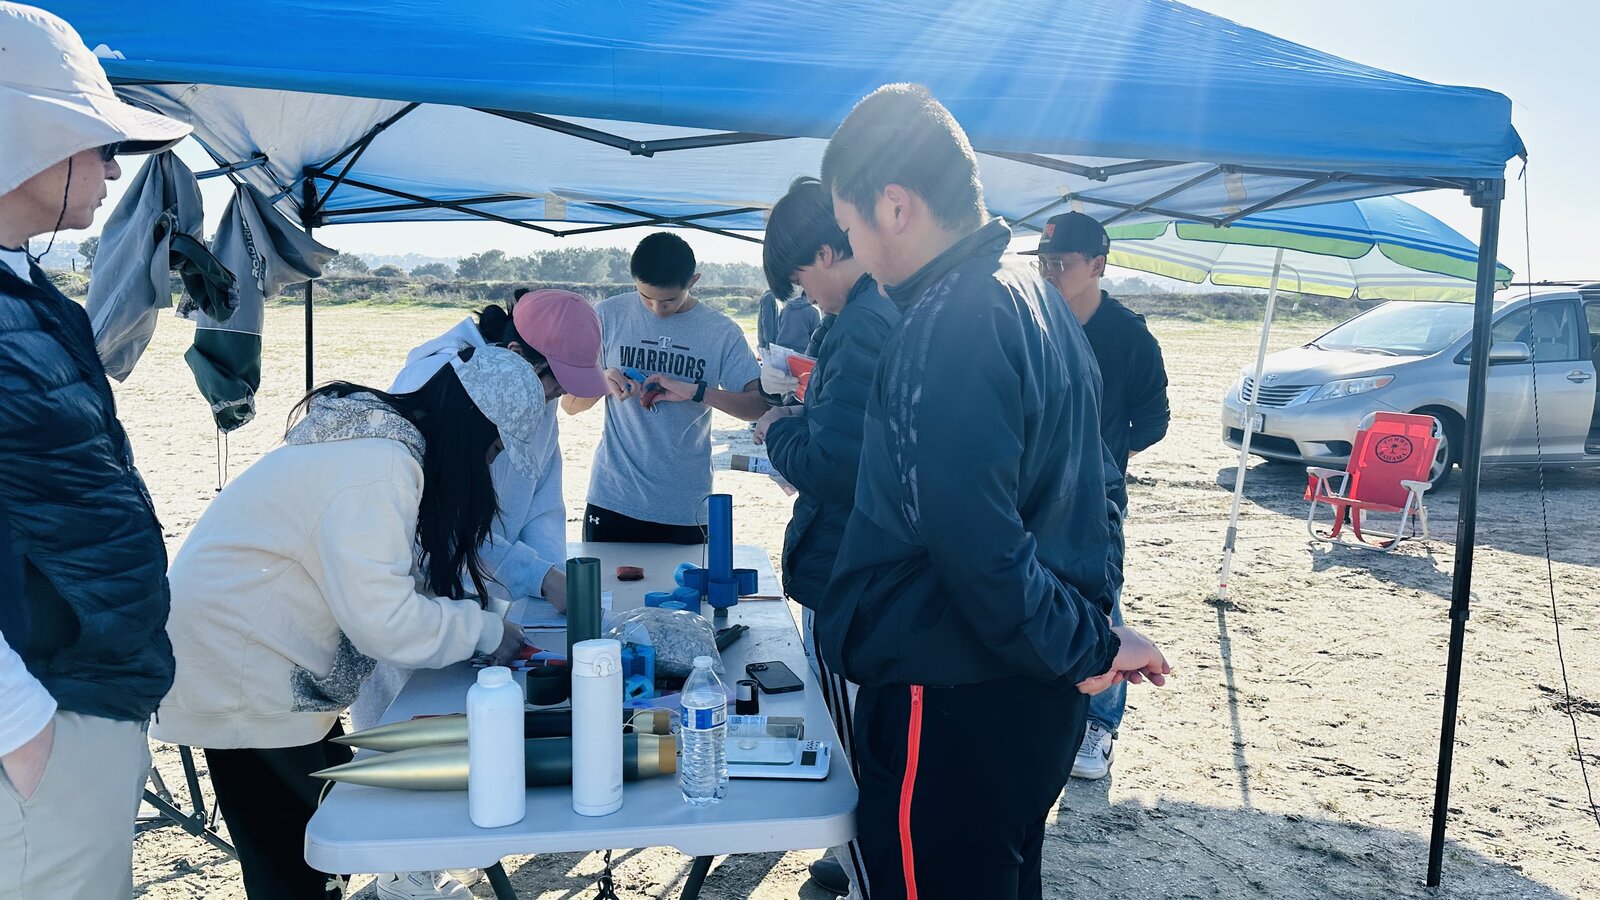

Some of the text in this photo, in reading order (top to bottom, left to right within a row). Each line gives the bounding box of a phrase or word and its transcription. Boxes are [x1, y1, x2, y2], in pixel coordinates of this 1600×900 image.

[658, 335, 672, 350] T
[620, 345, 706, 380] WARRIORS
[1383, 437, 1408, 446] TOMMY
[1379, 450, 1407, 460] BAHAMA
